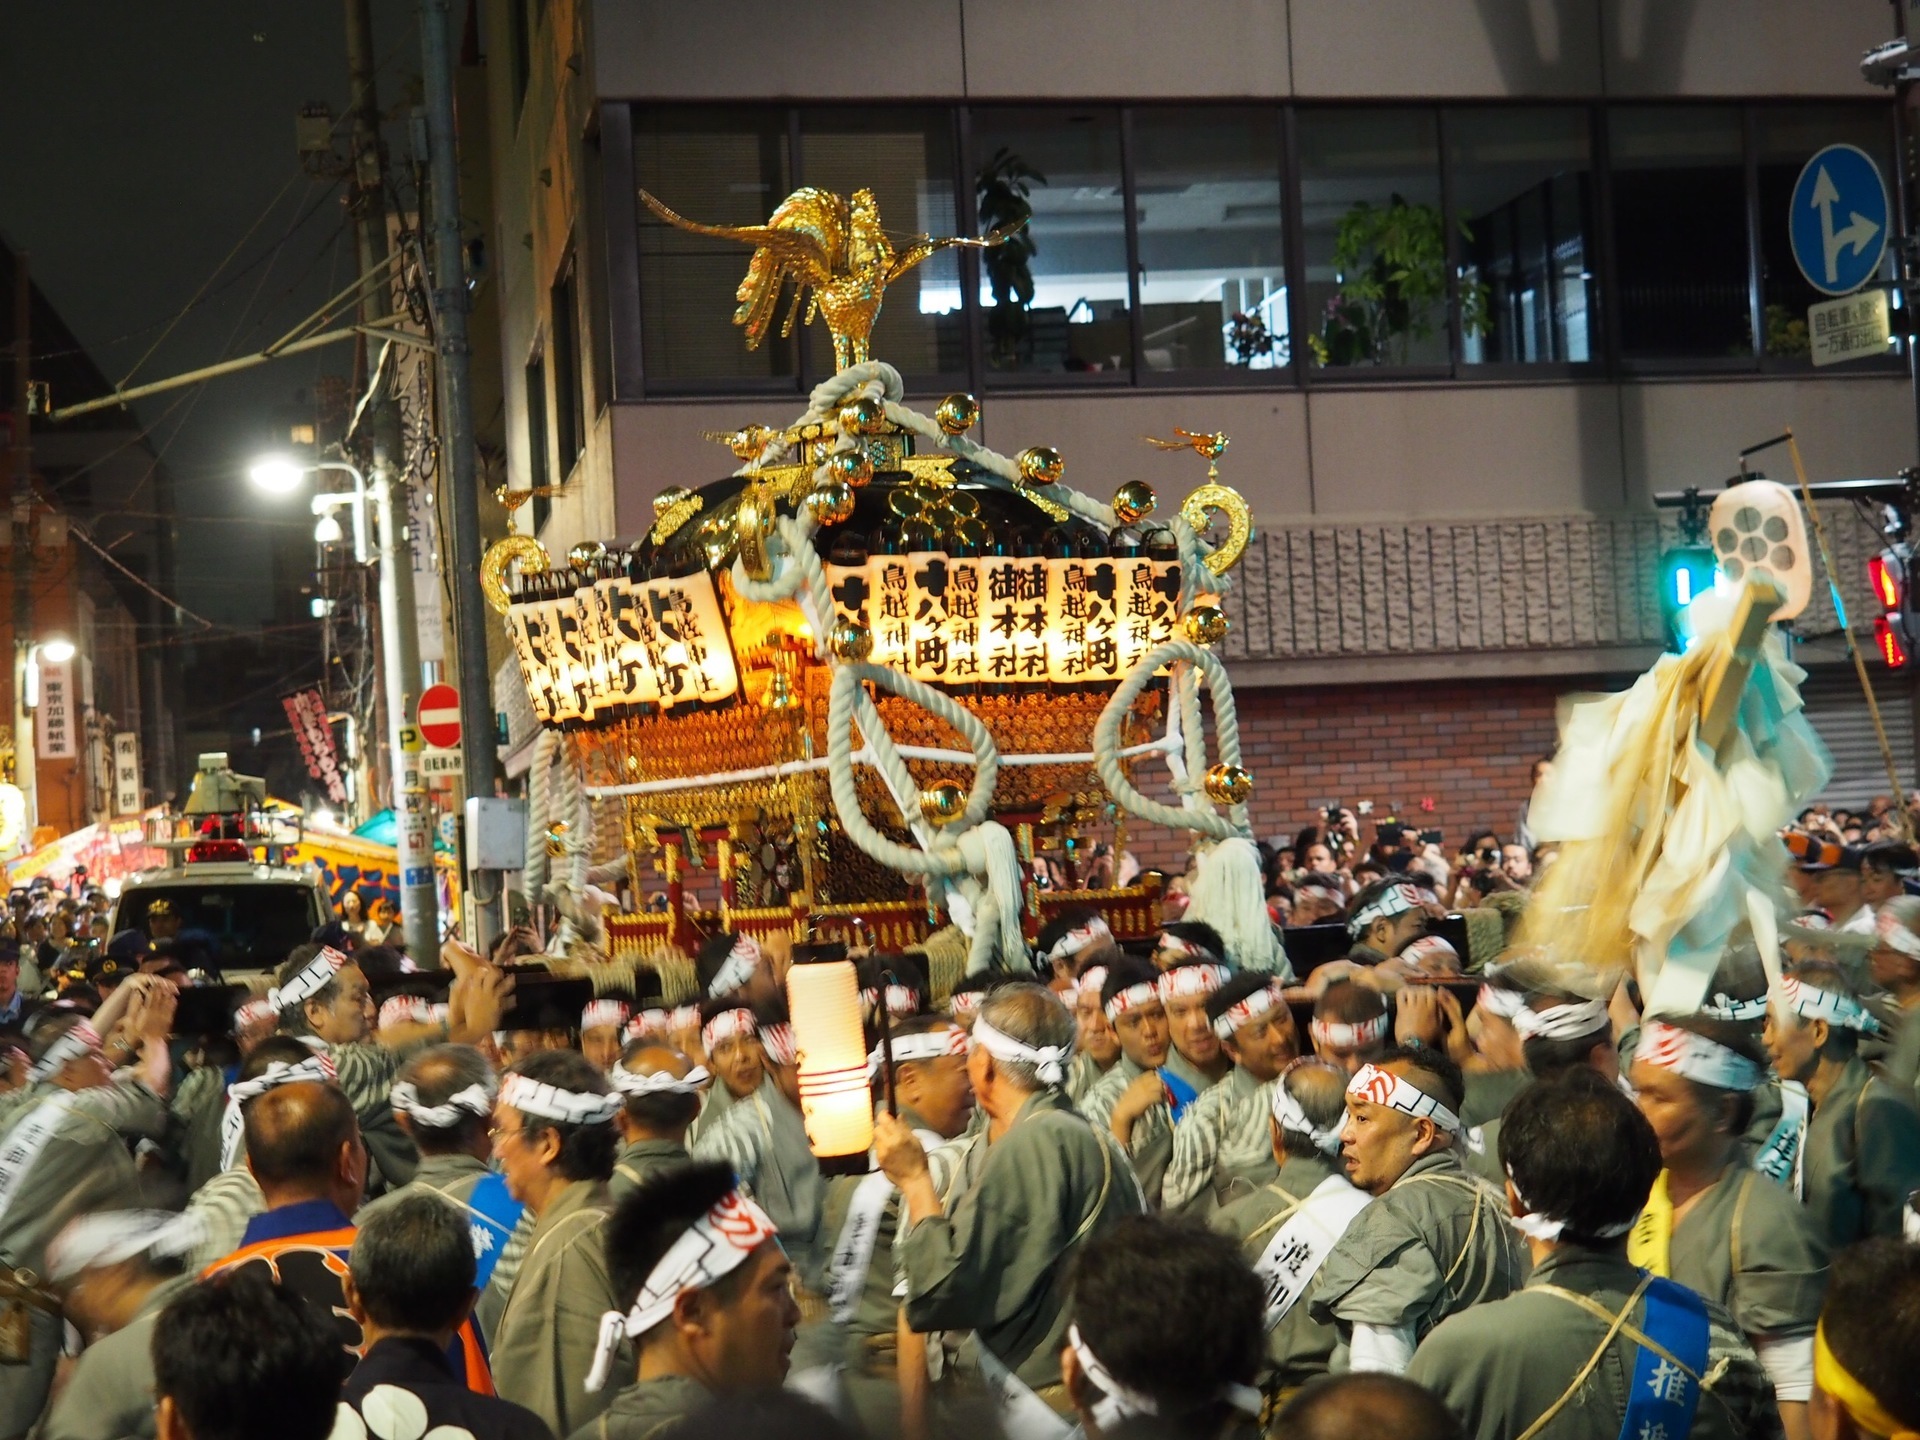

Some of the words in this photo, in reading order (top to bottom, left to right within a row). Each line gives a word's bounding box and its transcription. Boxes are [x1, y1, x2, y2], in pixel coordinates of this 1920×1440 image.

[988, 563, 1018, 678] 御本社
[1018, 563, 1049, 678] 御本社
[1060, 563, 1086, 676] 鳥越神社
